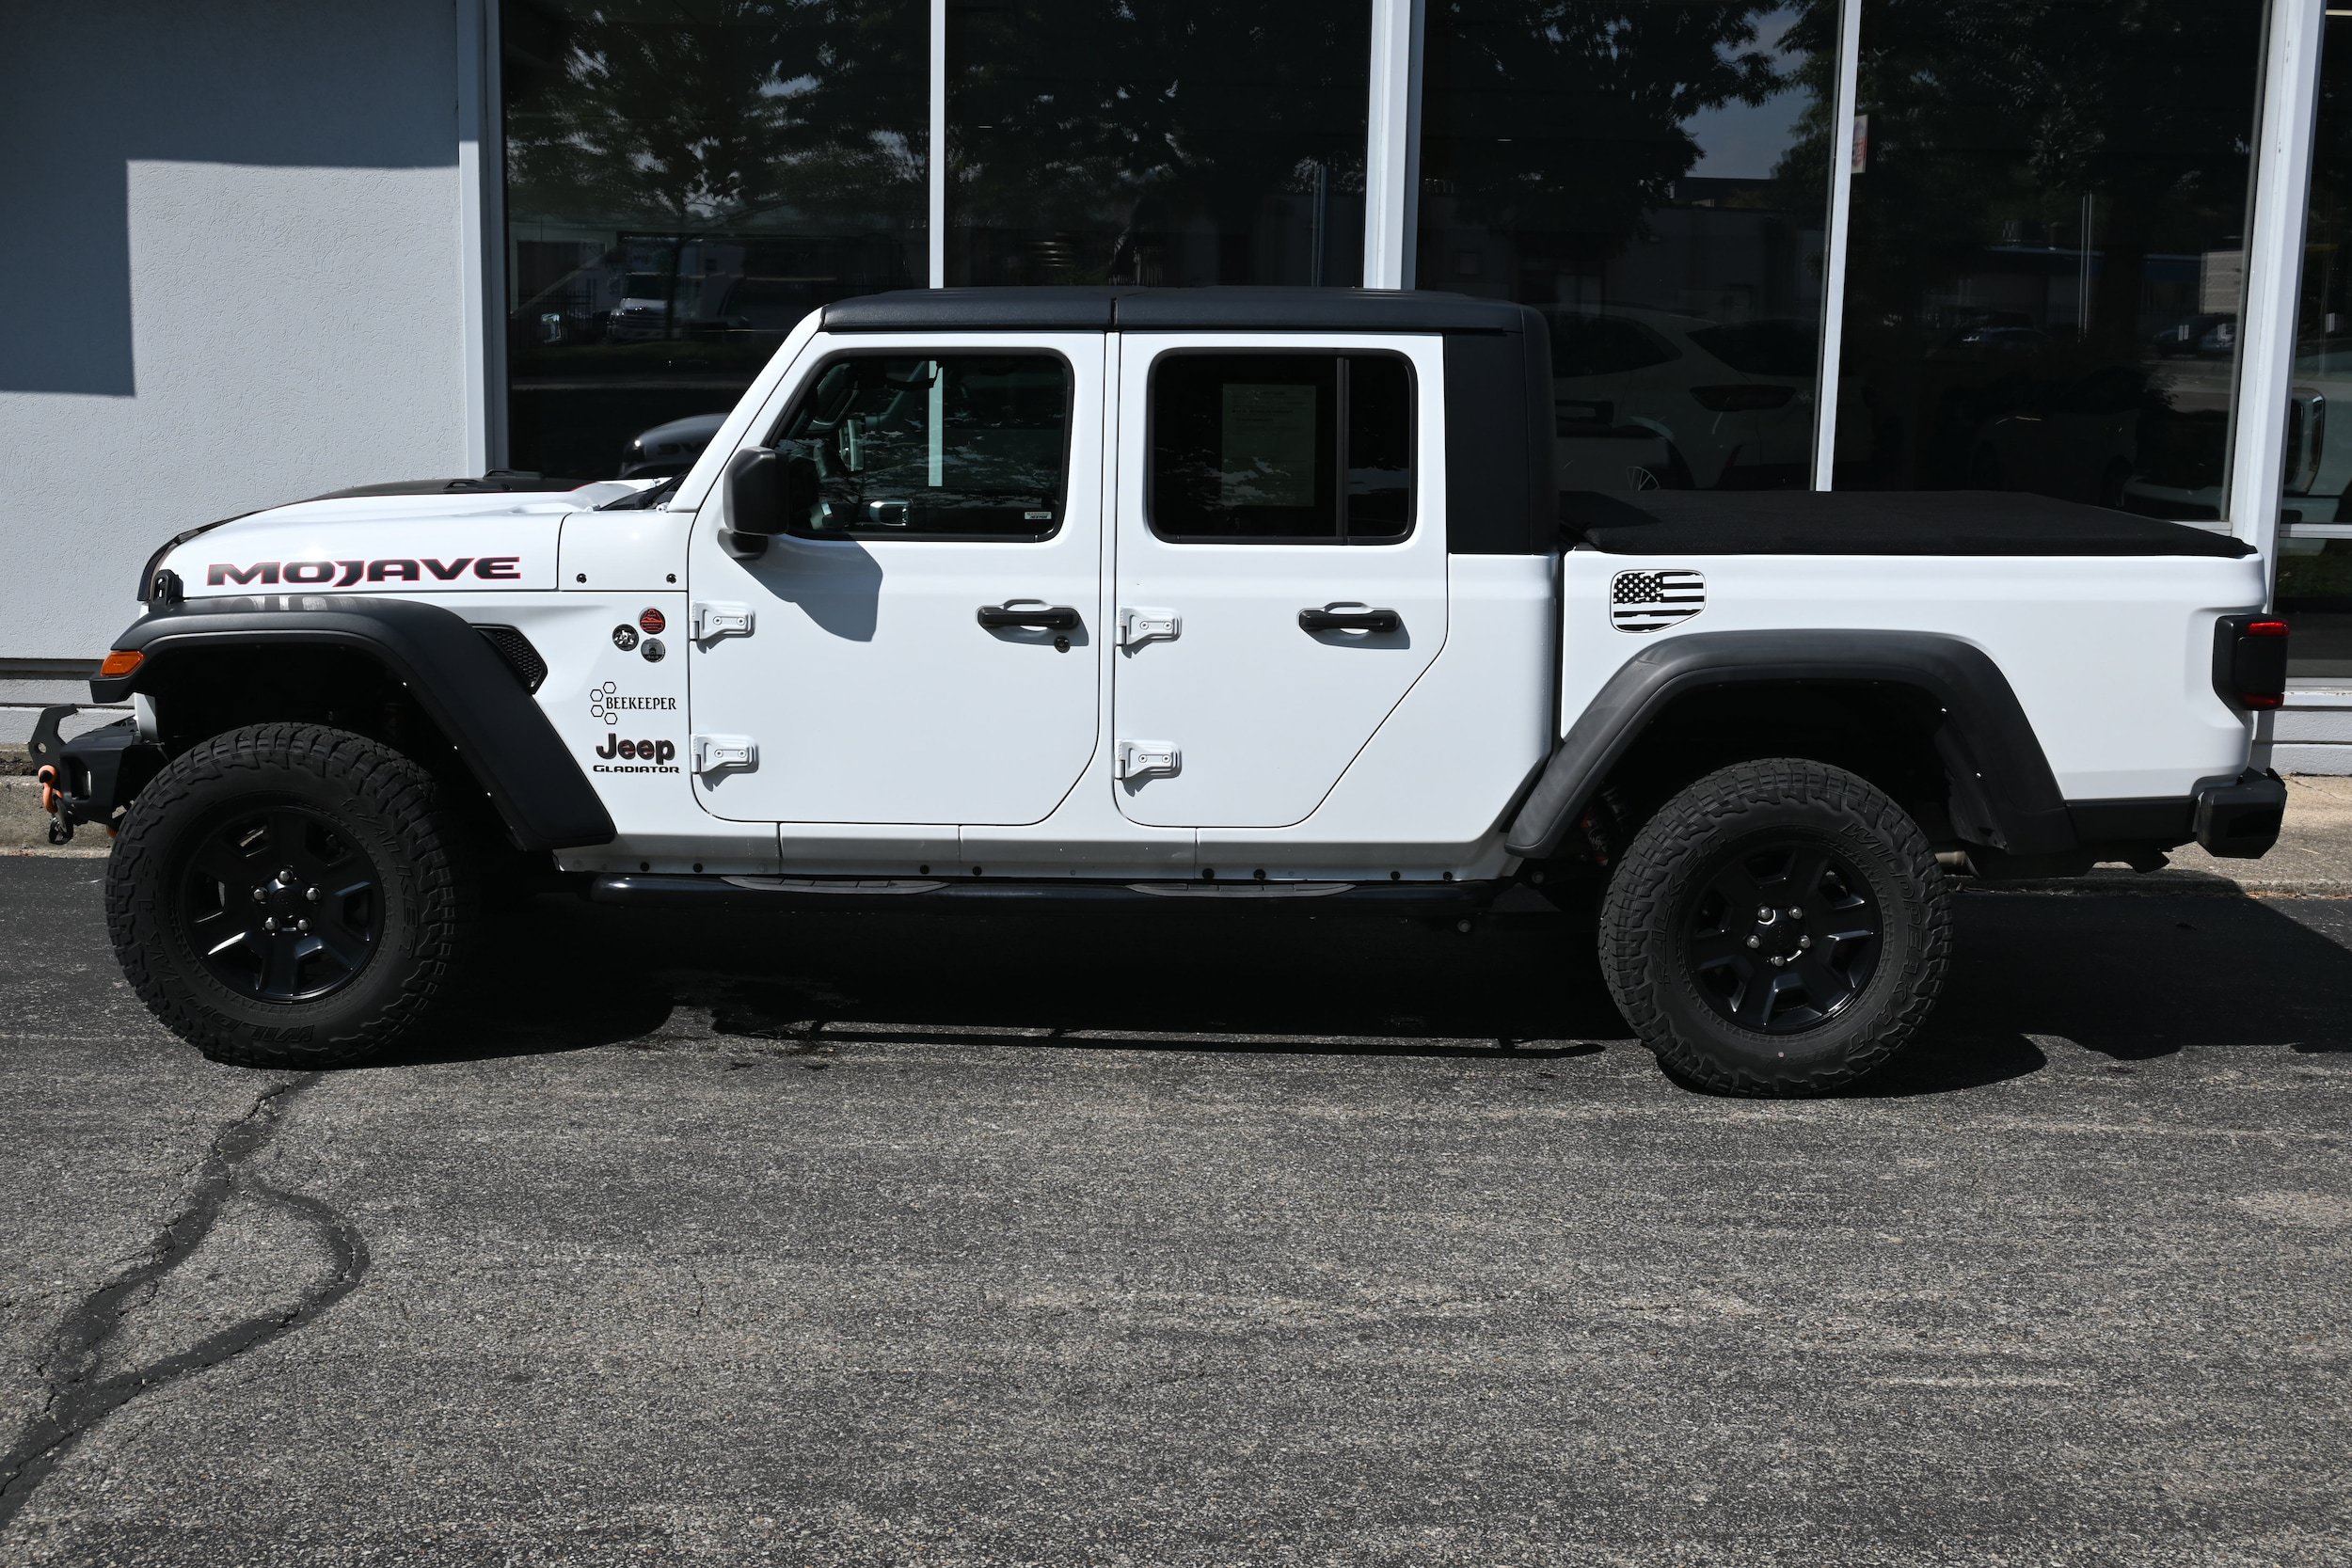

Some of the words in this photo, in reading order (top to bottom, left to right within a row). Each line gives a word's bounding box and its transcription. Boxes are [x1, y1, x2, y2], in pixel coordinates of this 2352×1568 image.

[207, 557, 521, 587] MOJAVE
[605, 696, 676, 710] BEEKEEPER
[596, 733, 675, 765] Jeep
[1840, 823, 1924, 1001] WILDPEAK
[1847, 1001, 1898, 1054] A/T
